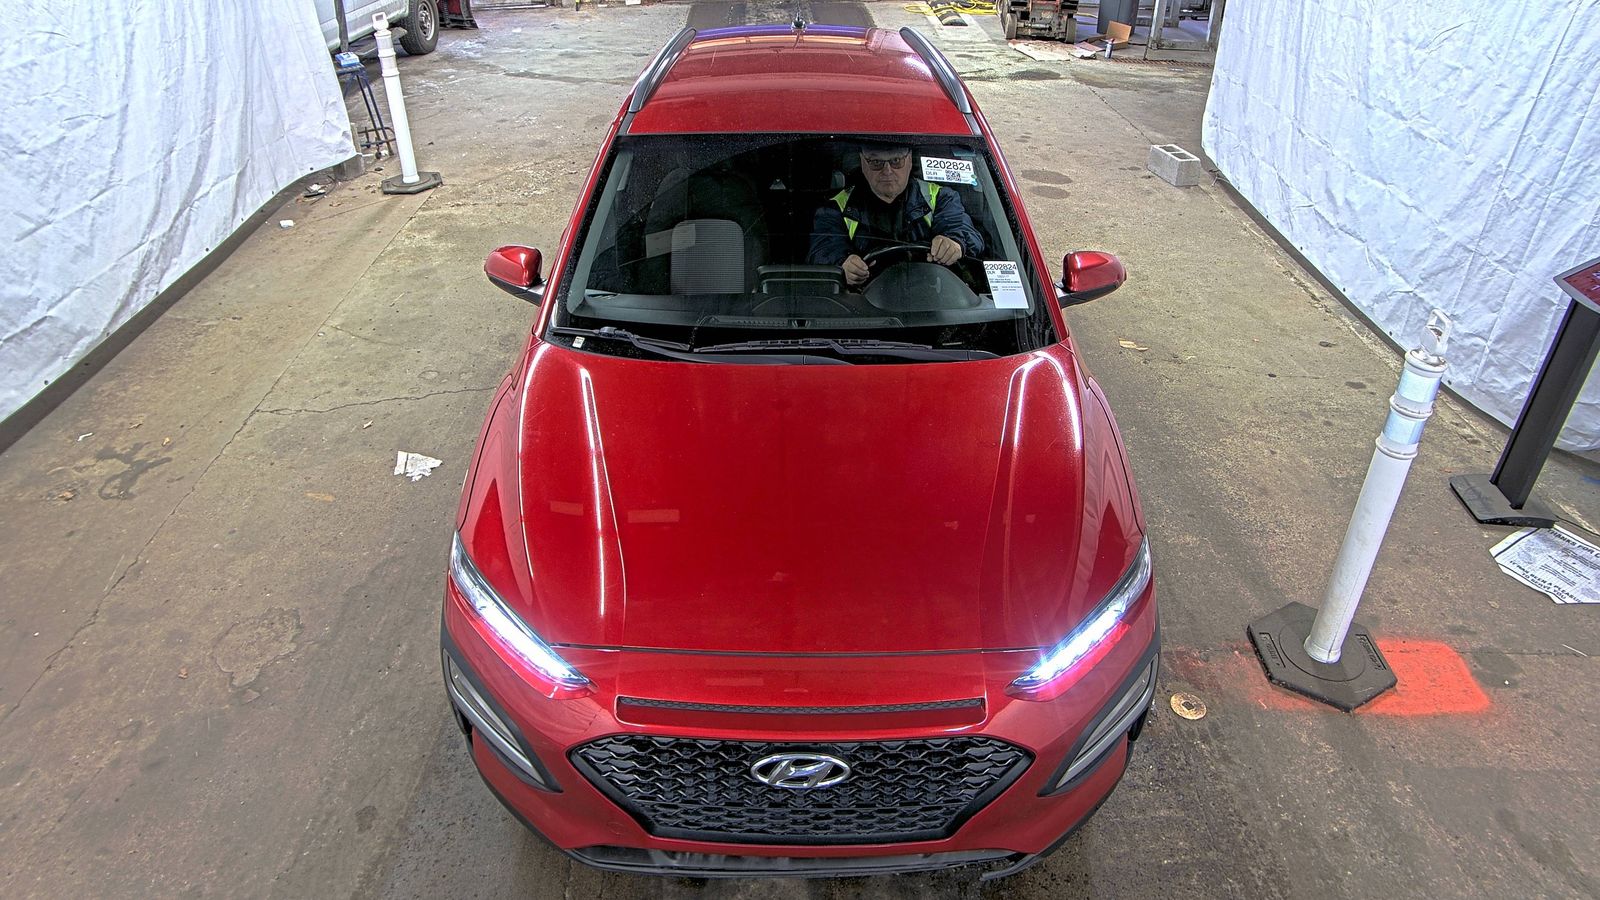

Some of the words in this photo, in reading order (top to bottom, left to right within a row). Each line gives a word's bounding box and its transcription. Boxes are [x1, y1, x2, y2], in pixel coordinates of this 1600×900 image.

[925, 159, 972, 171] 2202824
[984, 263, 1017, 271] 2202824
[1547, 529, 1577, 546] THANKS
[1577, 544, 1595, 554] FOR
[1530, 573, 1547, 584] BEEN
[1553, 589, 1567, 600] YOU
